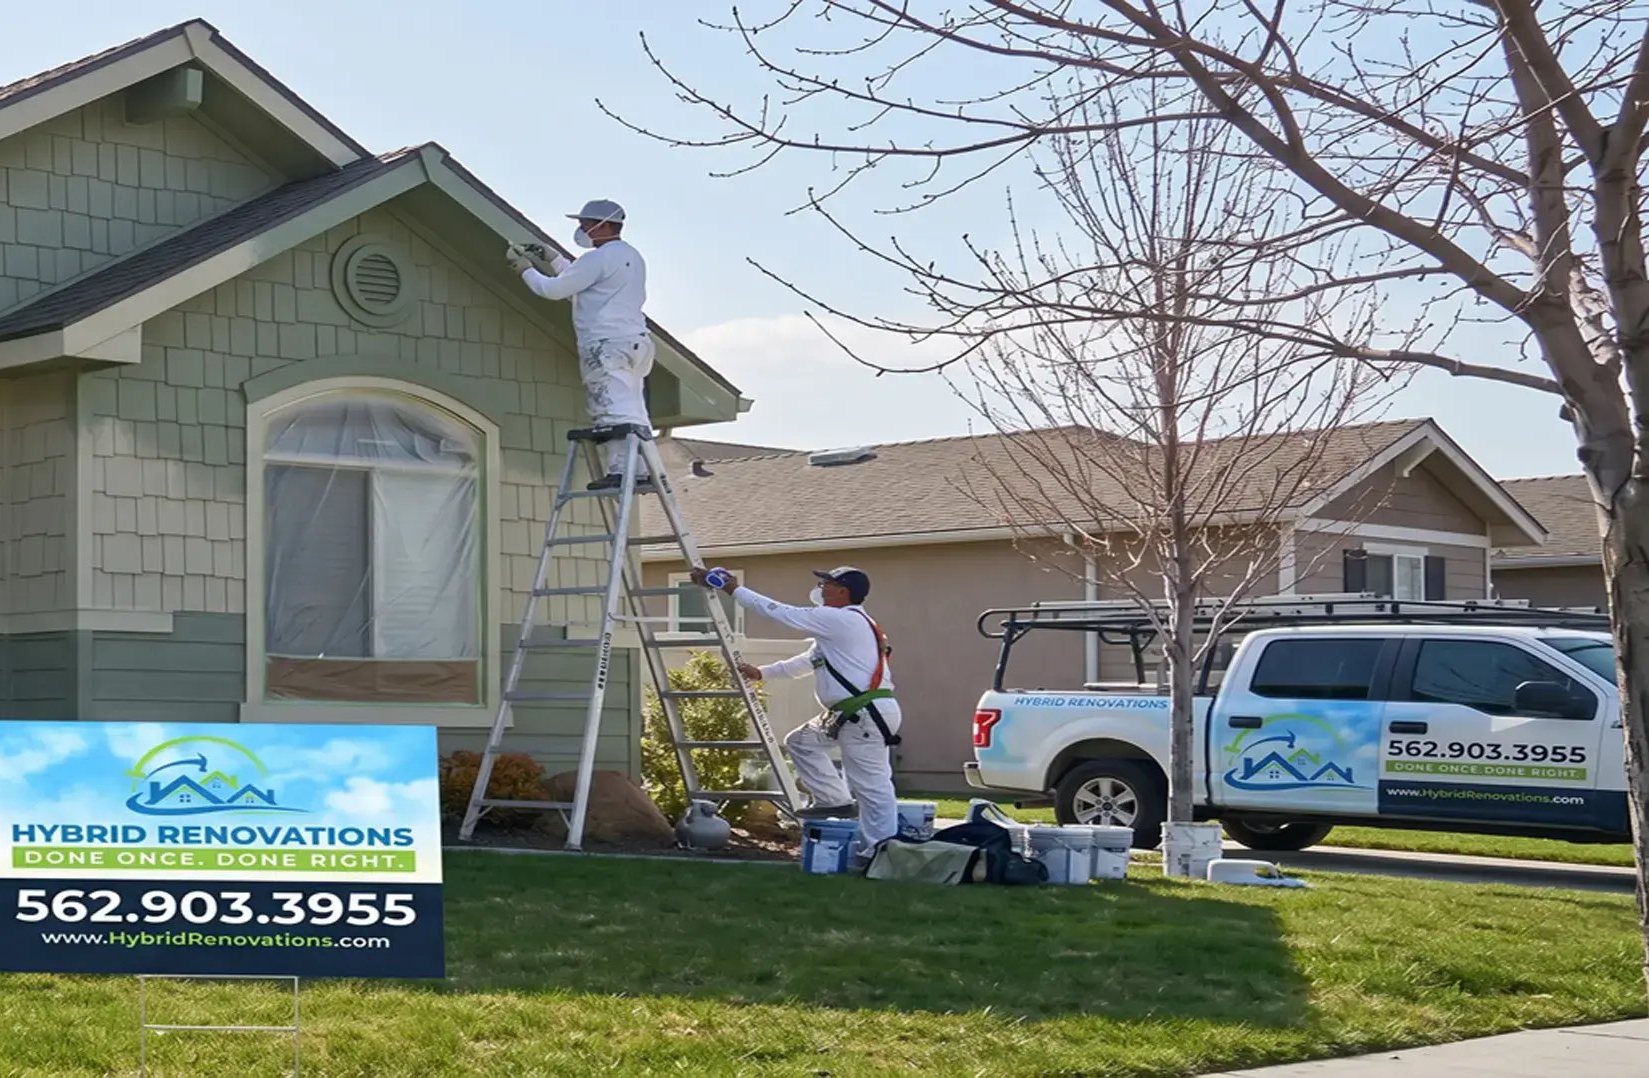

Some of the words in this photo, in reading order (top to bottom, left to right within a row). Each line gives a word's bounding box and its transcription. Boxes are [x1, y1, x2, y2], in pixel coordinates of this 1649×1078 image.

[1014, 697, 1065, 707] HYBRID
[1068, 698, 1168, 709] RENOVATIONS
[1388, 740, 1587, 763] 562.903.3955
[1394, 762, 1433, 772] DONE
[1532, 768, 1580, 778] RIGHT.
[1387, 787, 1584, 804] www.HybridRenovations.com
[12, 824, 146, 845] HYBRID
[158, 825, 414, 847] RENOVATIONS
[24, 850, 107, 866] DONE
[117, 851, 205, 867] ONCE.
[216, 852, 297, 868] DONE
[310, 853, 405, 869] RIGHT.
[16, 889, 416, 925] 562.903.3955
[42, 931, 390, 949] www.HybridRenovations.com
